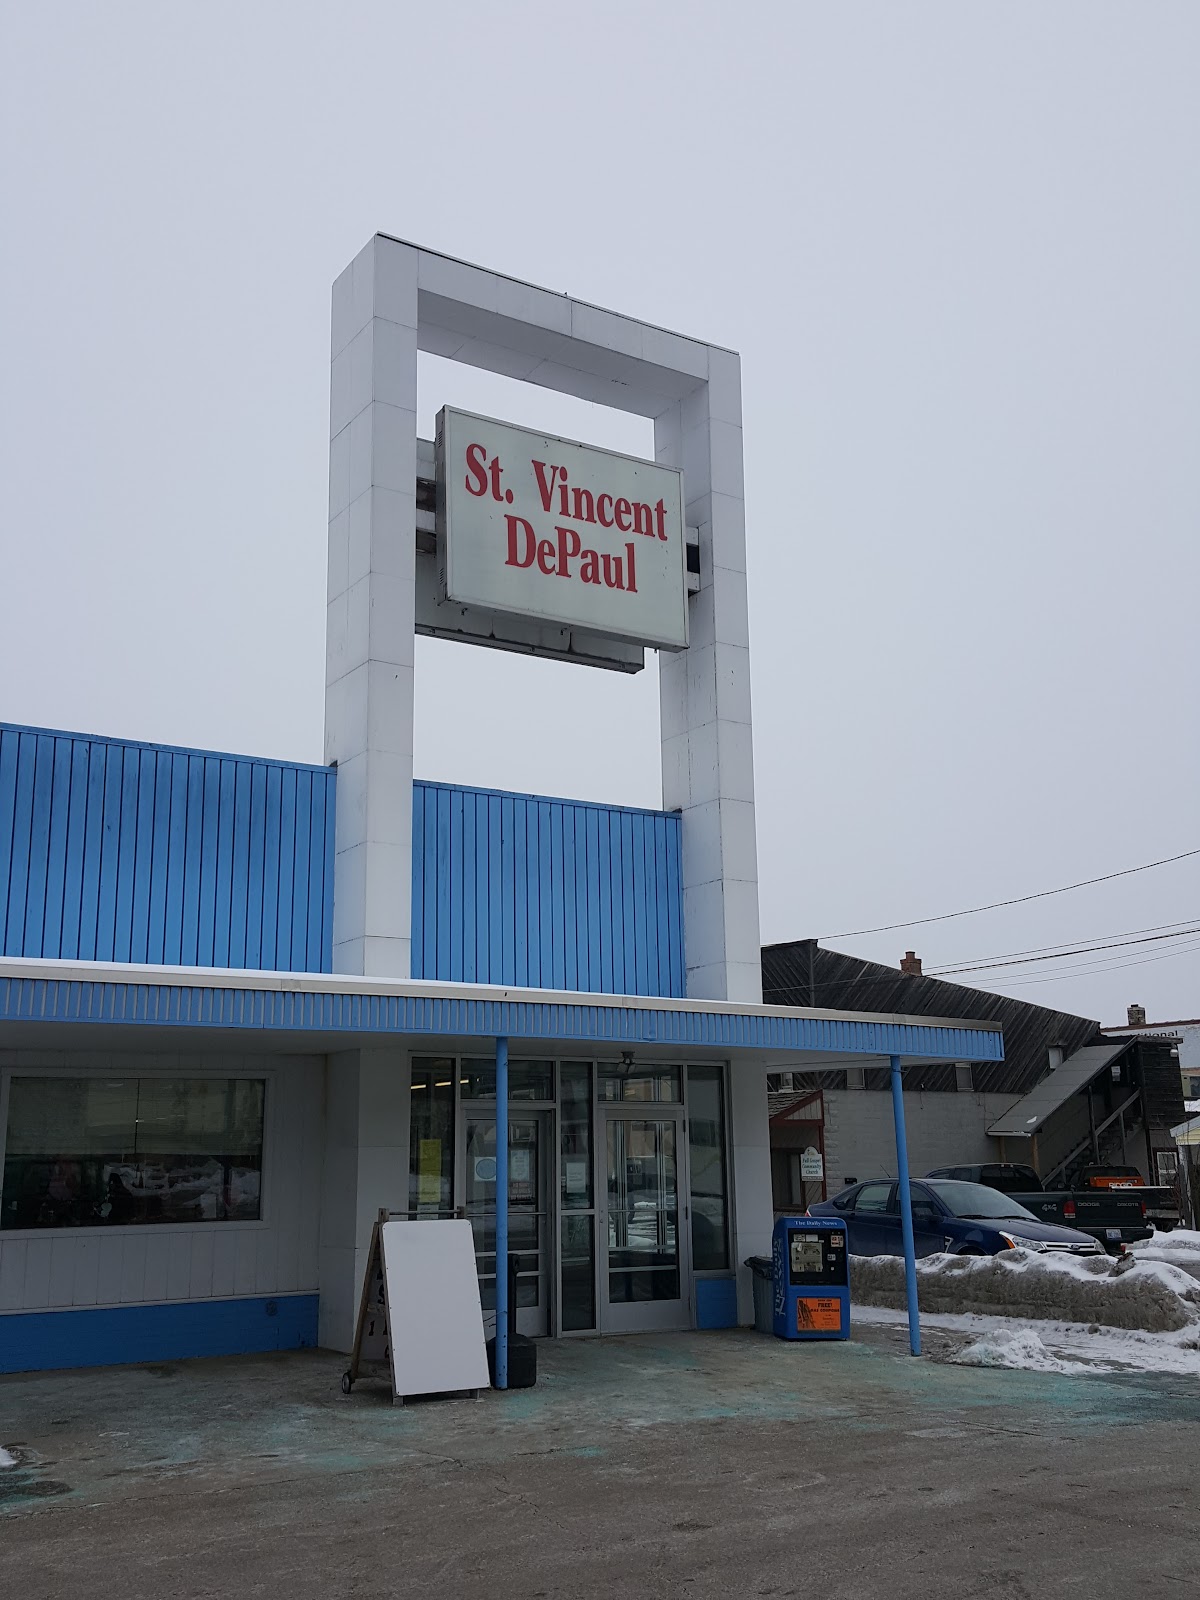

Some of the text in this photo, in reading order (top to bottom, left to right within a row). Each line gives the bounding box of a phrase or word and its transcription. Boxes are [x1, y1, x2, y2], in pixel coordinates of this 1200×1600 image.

[466, 443, 668, 541] St. Vincent
[504, 514, 638, 593] DePaul
